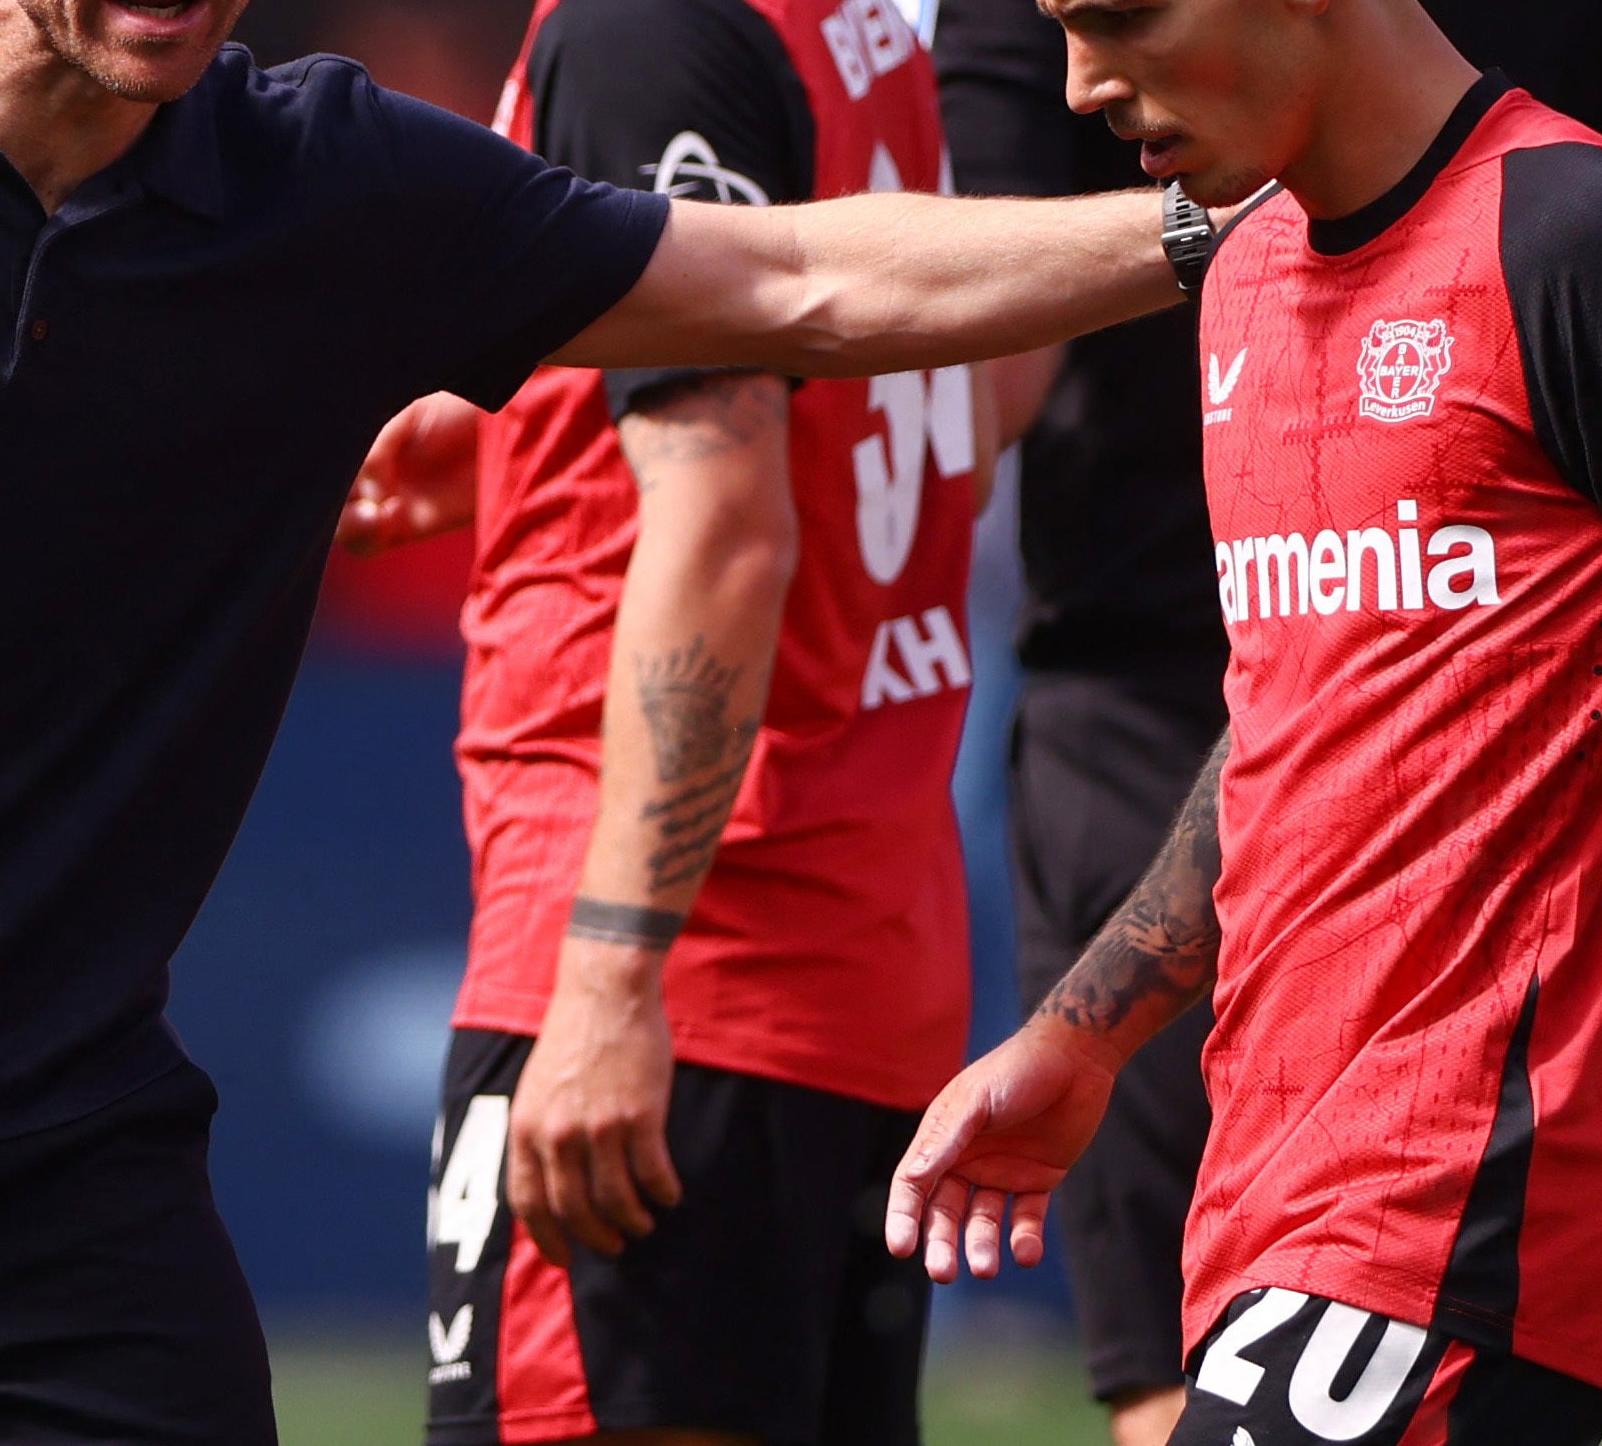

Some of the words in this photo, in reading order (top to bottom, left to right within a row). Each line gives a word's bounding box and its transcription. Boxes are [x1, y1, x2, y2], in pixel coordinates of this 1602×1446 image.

[1380, 365, 1419, 376] BAYER
[1364, 398, 1426, 419] Leverkusen
[1215, 499, 1502, 625] armenia
[1195, 1286, 1428, 1441] 20
